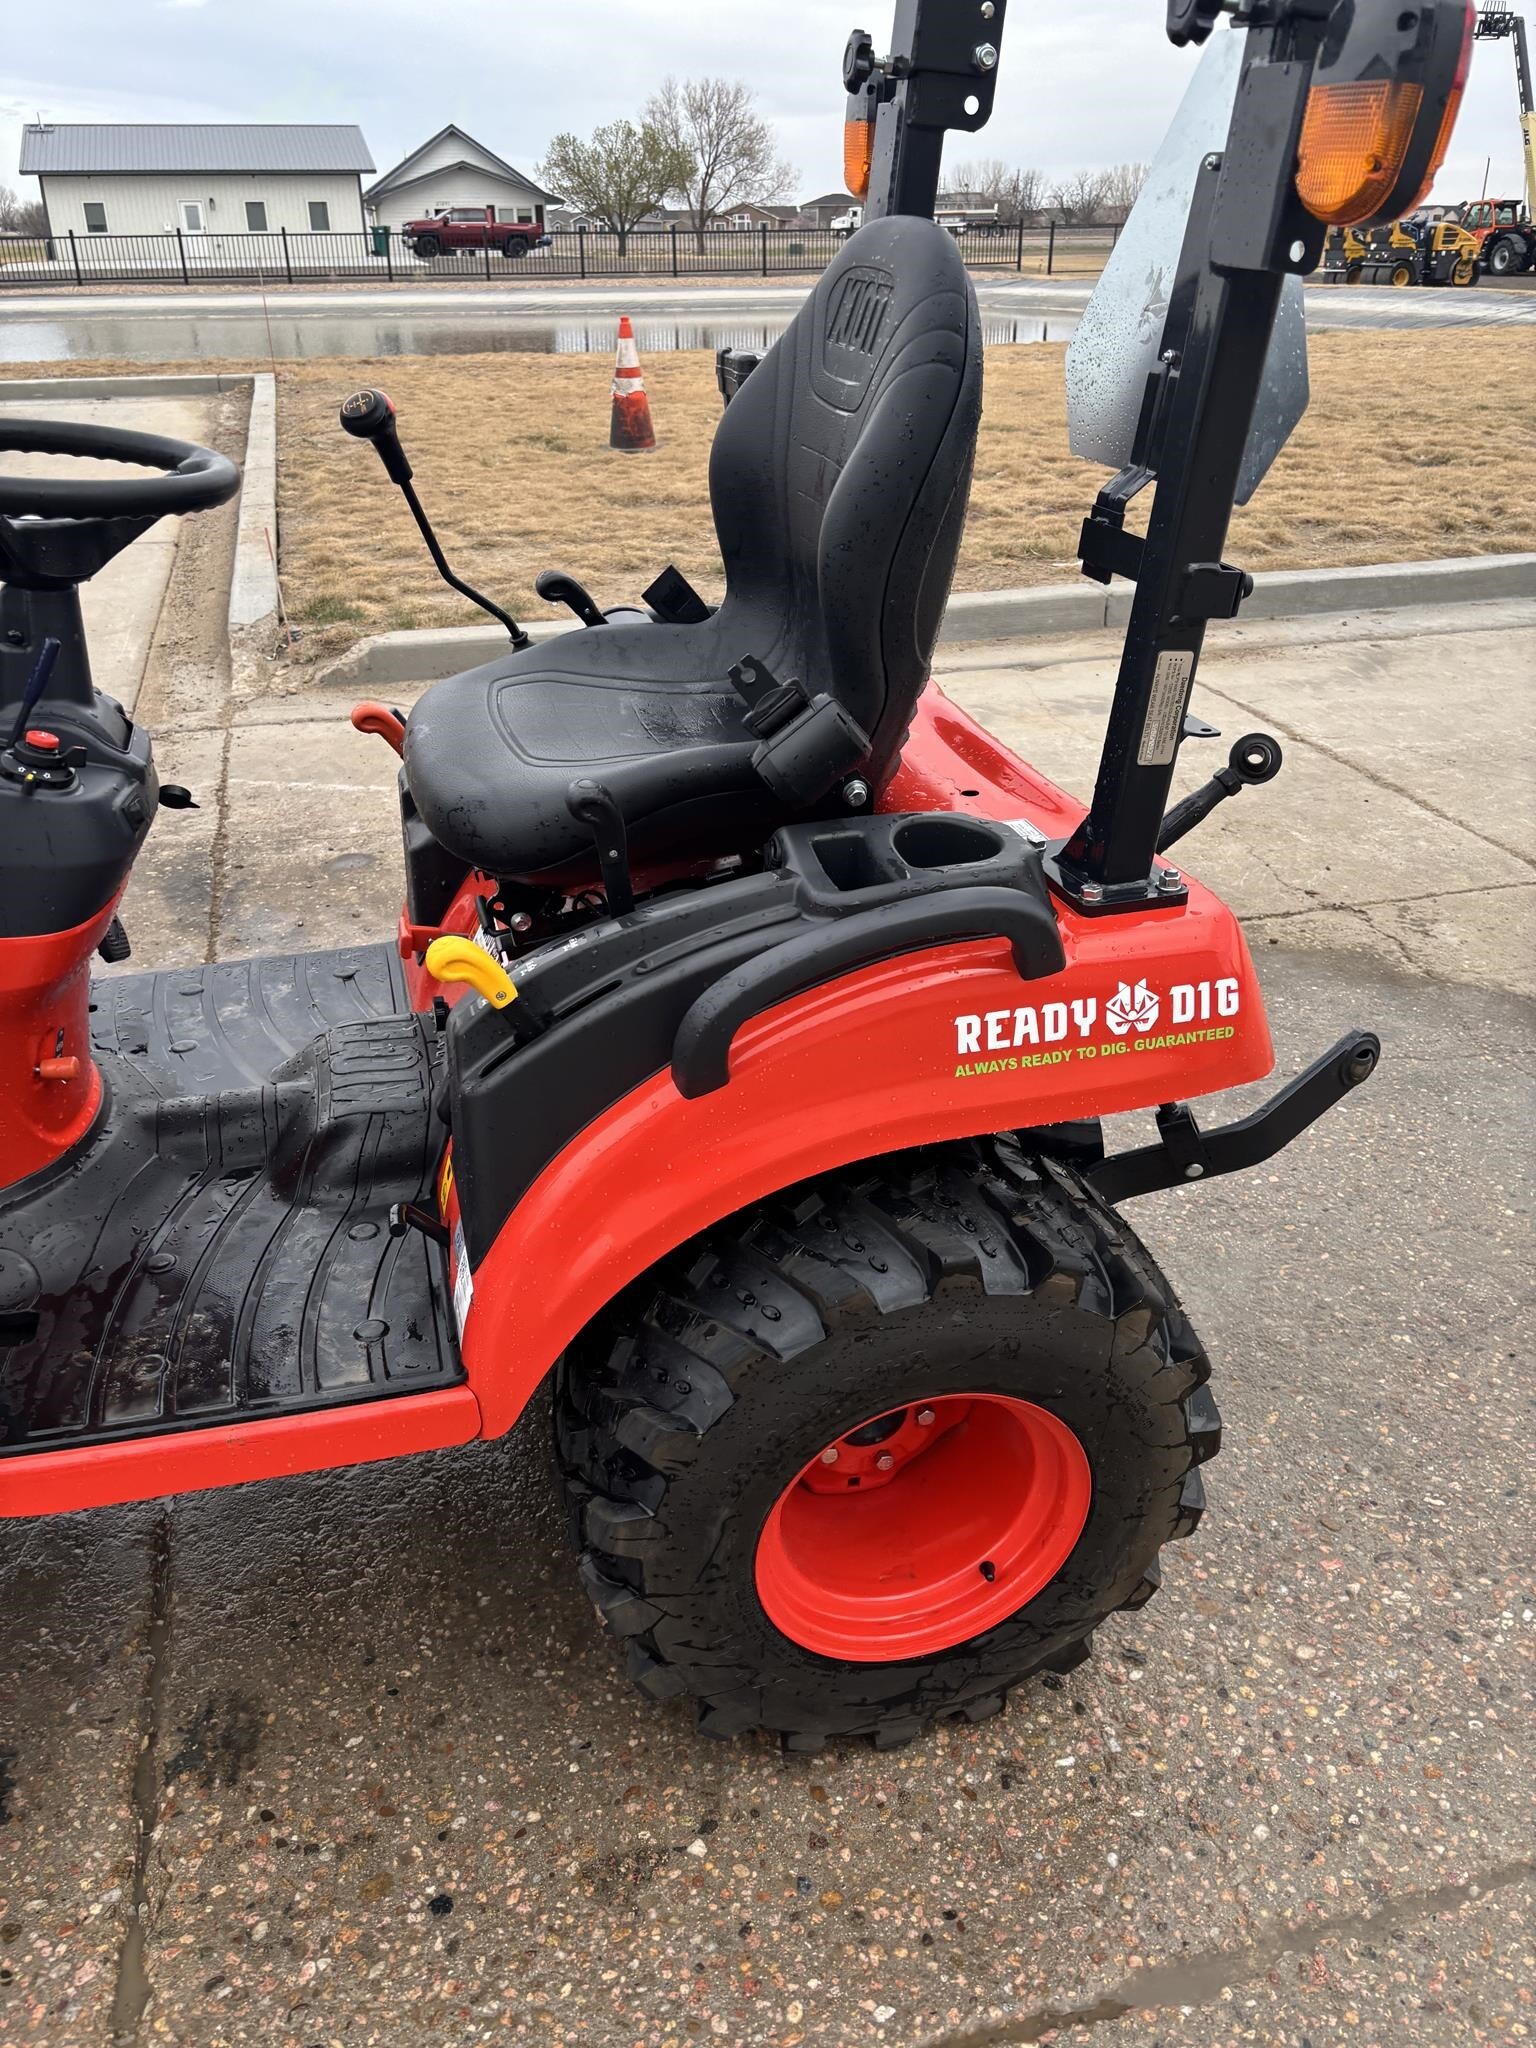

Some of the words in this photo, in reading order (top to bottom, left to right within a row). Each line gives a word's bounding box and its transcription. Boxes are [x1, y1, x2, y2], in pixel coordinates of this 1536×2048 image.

[1175, 677, 1187, 704] Daedong
[1169, 705, 1182, 740] Corporation
[954, 997, 1097, 1055] READY
[1169, 977, 1240, 1024] DIG
[955, 1058, 1018, 1078] ALWAYS
[1021, 1050, 1073, 1068] READY
[1077, 1046, 1097, 1059] TO
[1100, 1041, 1131, 1055] DIG.
[1135, 1026, 1235, 1052] GUARANTEED
